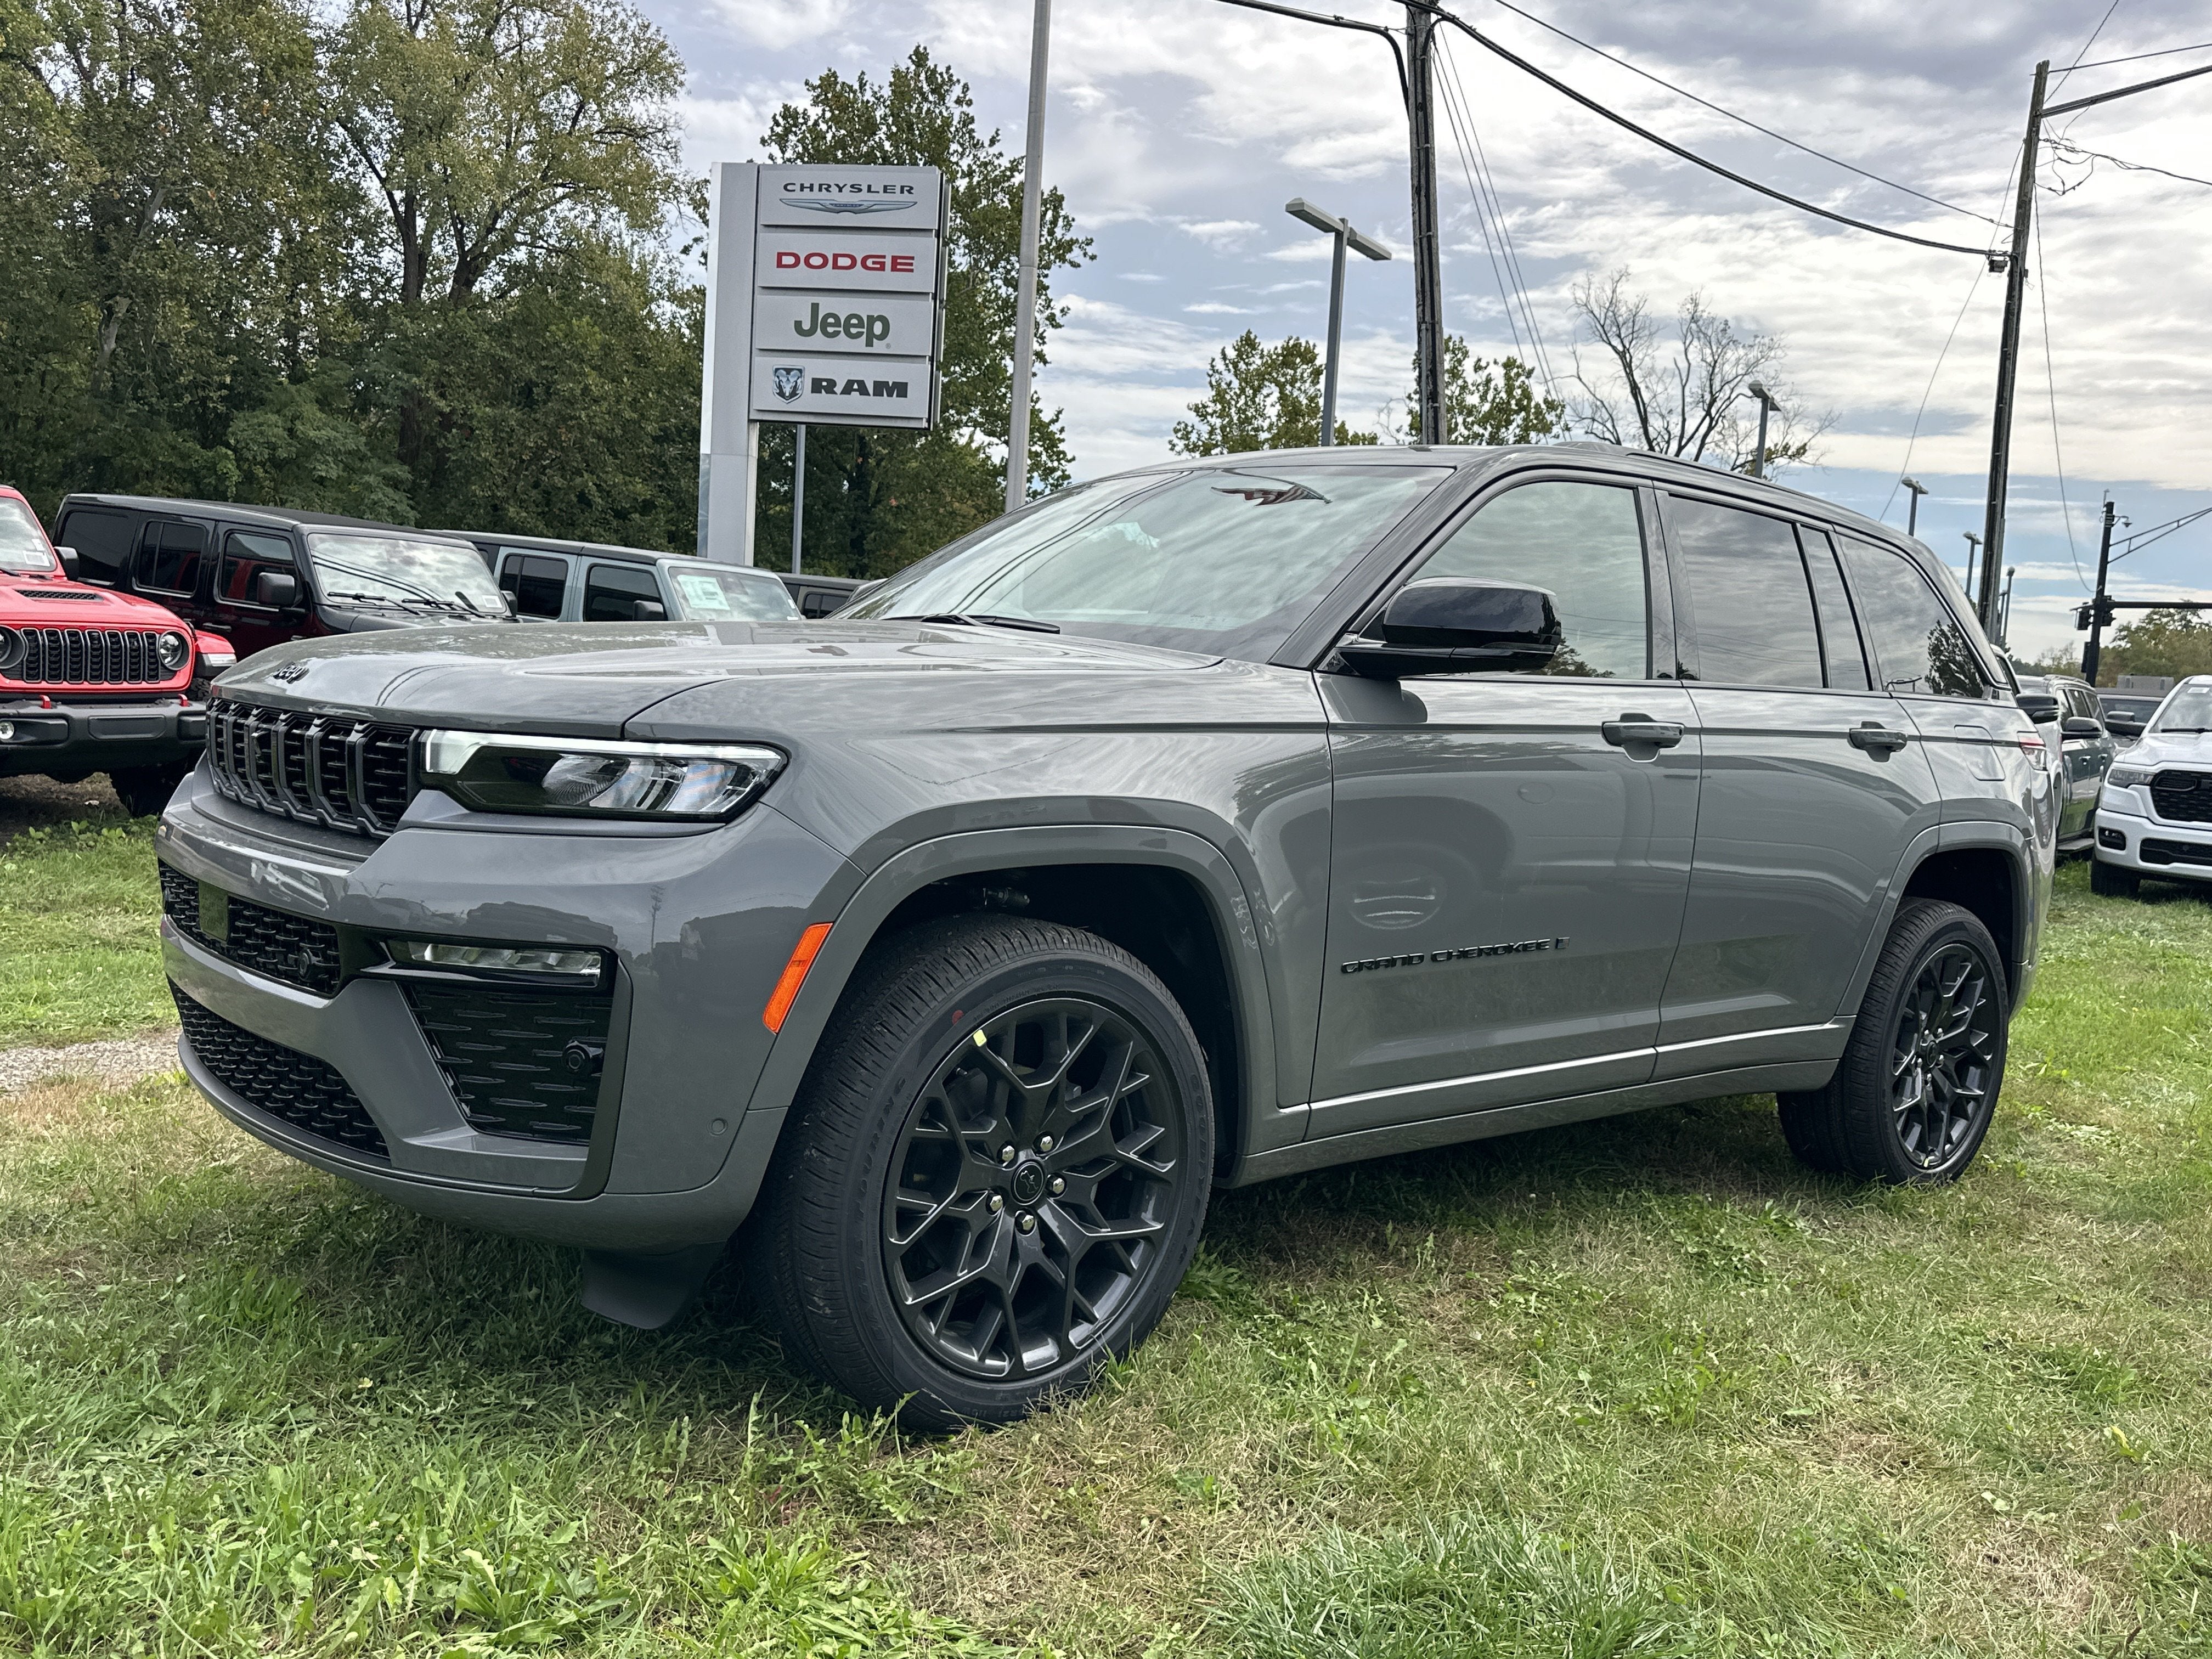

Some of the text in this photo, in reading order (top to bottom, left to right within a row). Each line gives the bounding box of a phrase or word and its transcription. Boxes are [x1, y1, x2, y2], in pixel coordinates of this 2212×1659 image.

[783, 183, 914, 194] CHRYSLER
[776, 252, 915, 273] DODGE
[794, 302, 890, 347] Jeep
[811, 377, 909, 398] RAM
[1341, 938, 1551, 974] GRAND CHEROKEE
